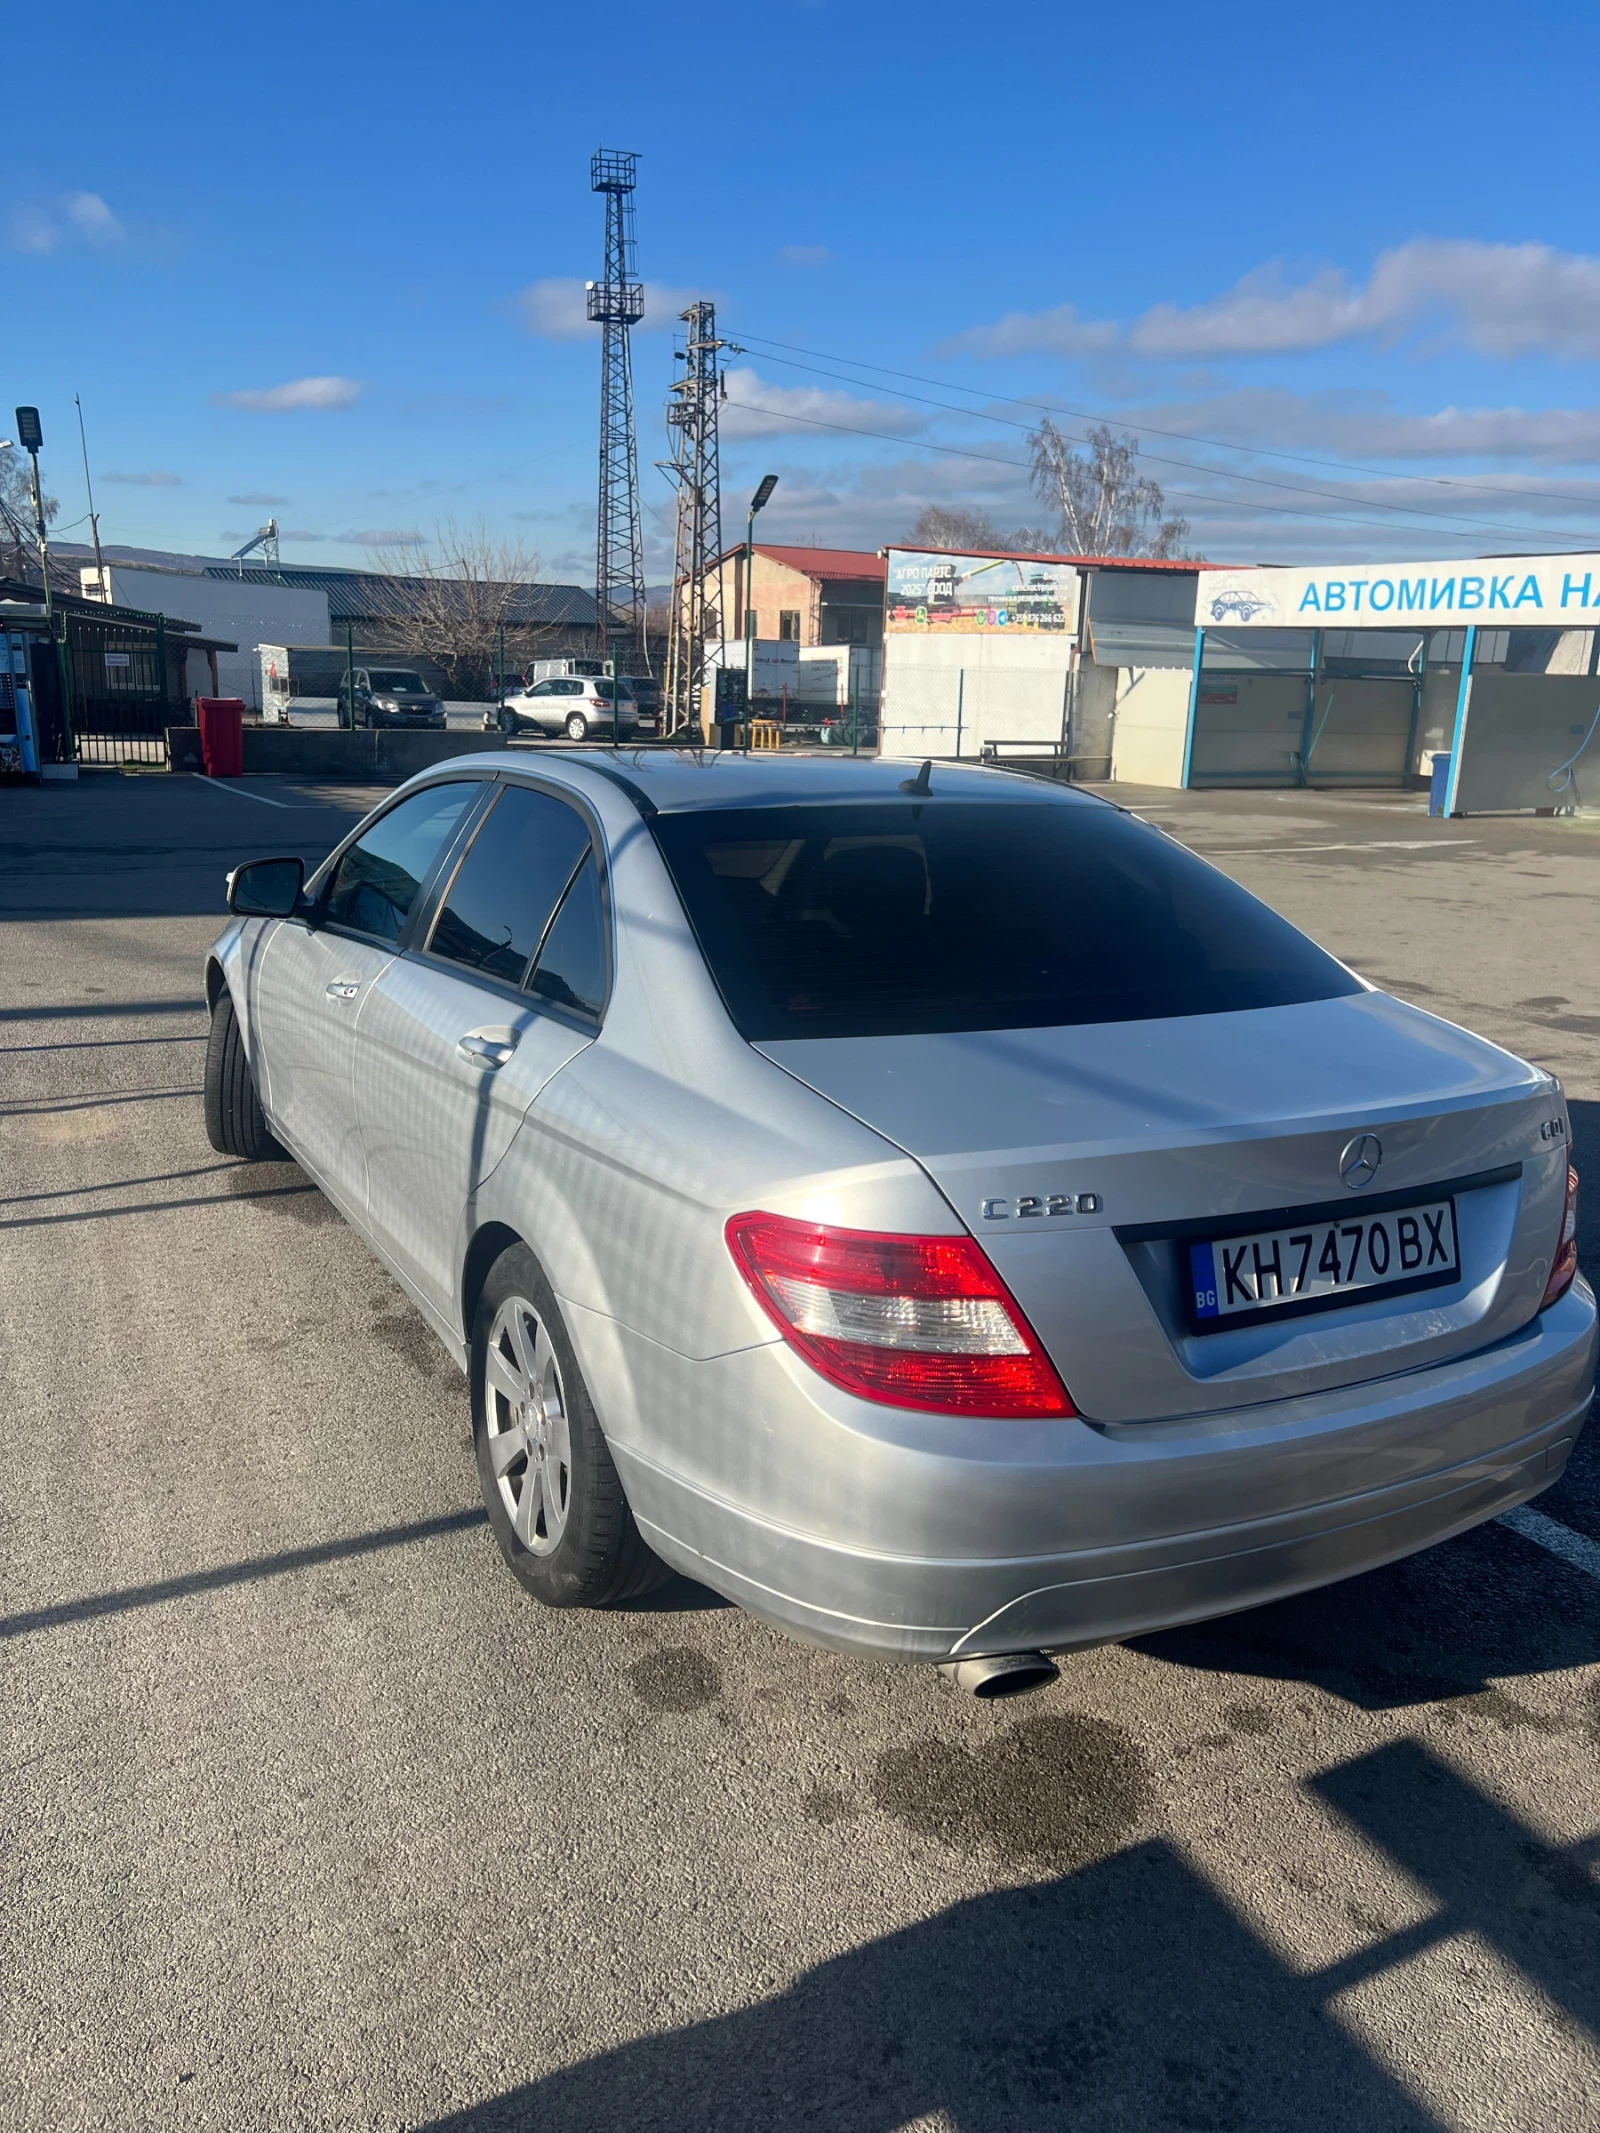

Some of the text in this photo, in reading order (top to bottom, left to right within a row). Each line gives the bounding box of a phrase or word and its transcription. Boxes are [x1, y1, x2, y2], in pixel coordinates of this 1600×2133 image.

[921, 565, 952, 579] ПАРТС
[1298, 572, 1600, 612] АВТОМИВКА Н
[981, 1193, 1103, 1221] C 220
[1195, 1290, 1216, 1309] BG
